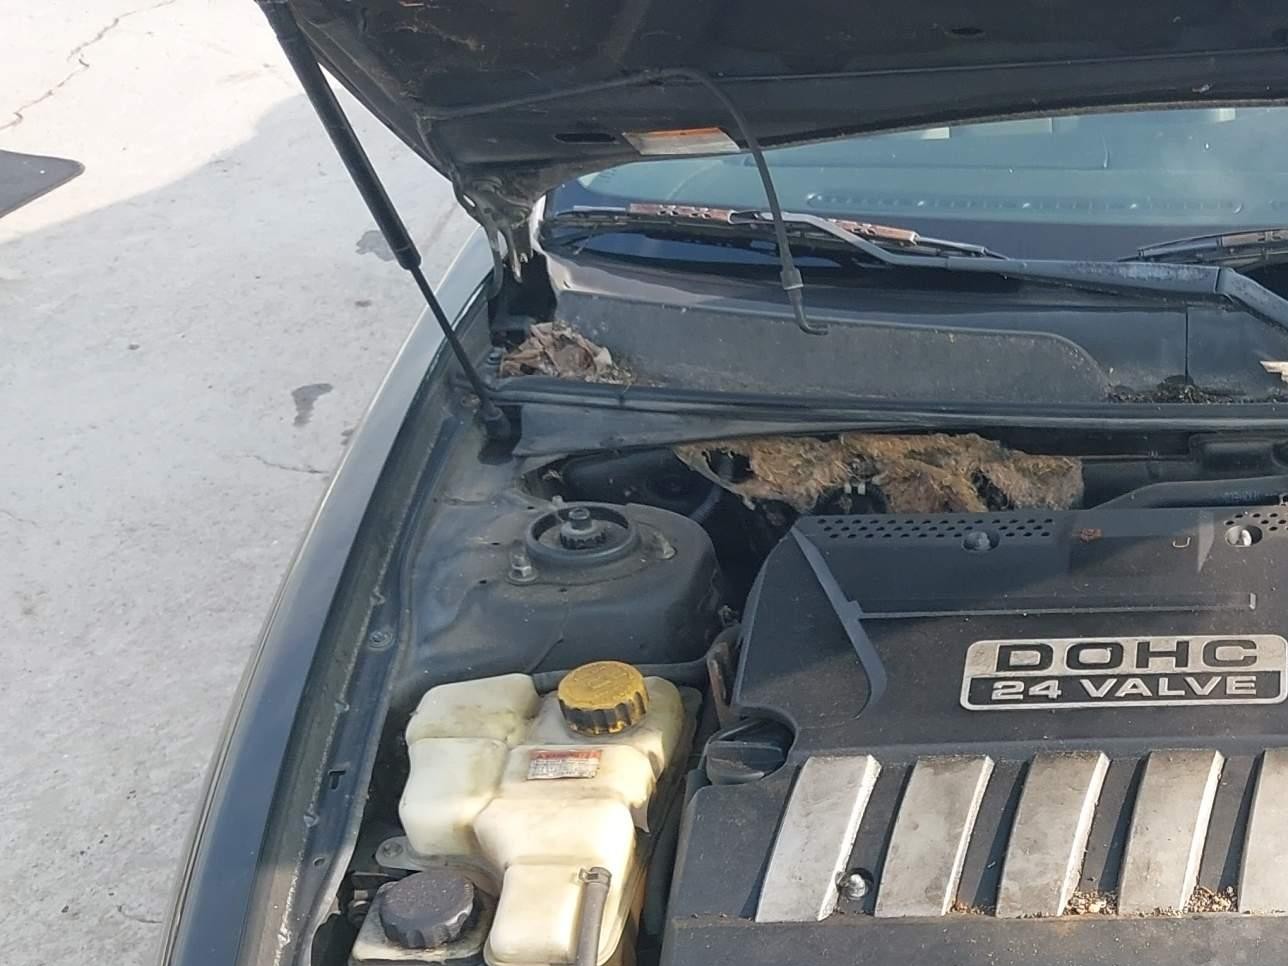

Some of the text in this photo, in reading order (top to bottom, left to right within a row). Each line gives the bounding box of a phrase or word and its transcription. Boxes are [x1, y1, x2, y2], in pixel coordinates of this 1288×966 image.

[996, 639, 1258, 673] DOHC
[991, 675, 1258, 701] 24 VALVE
